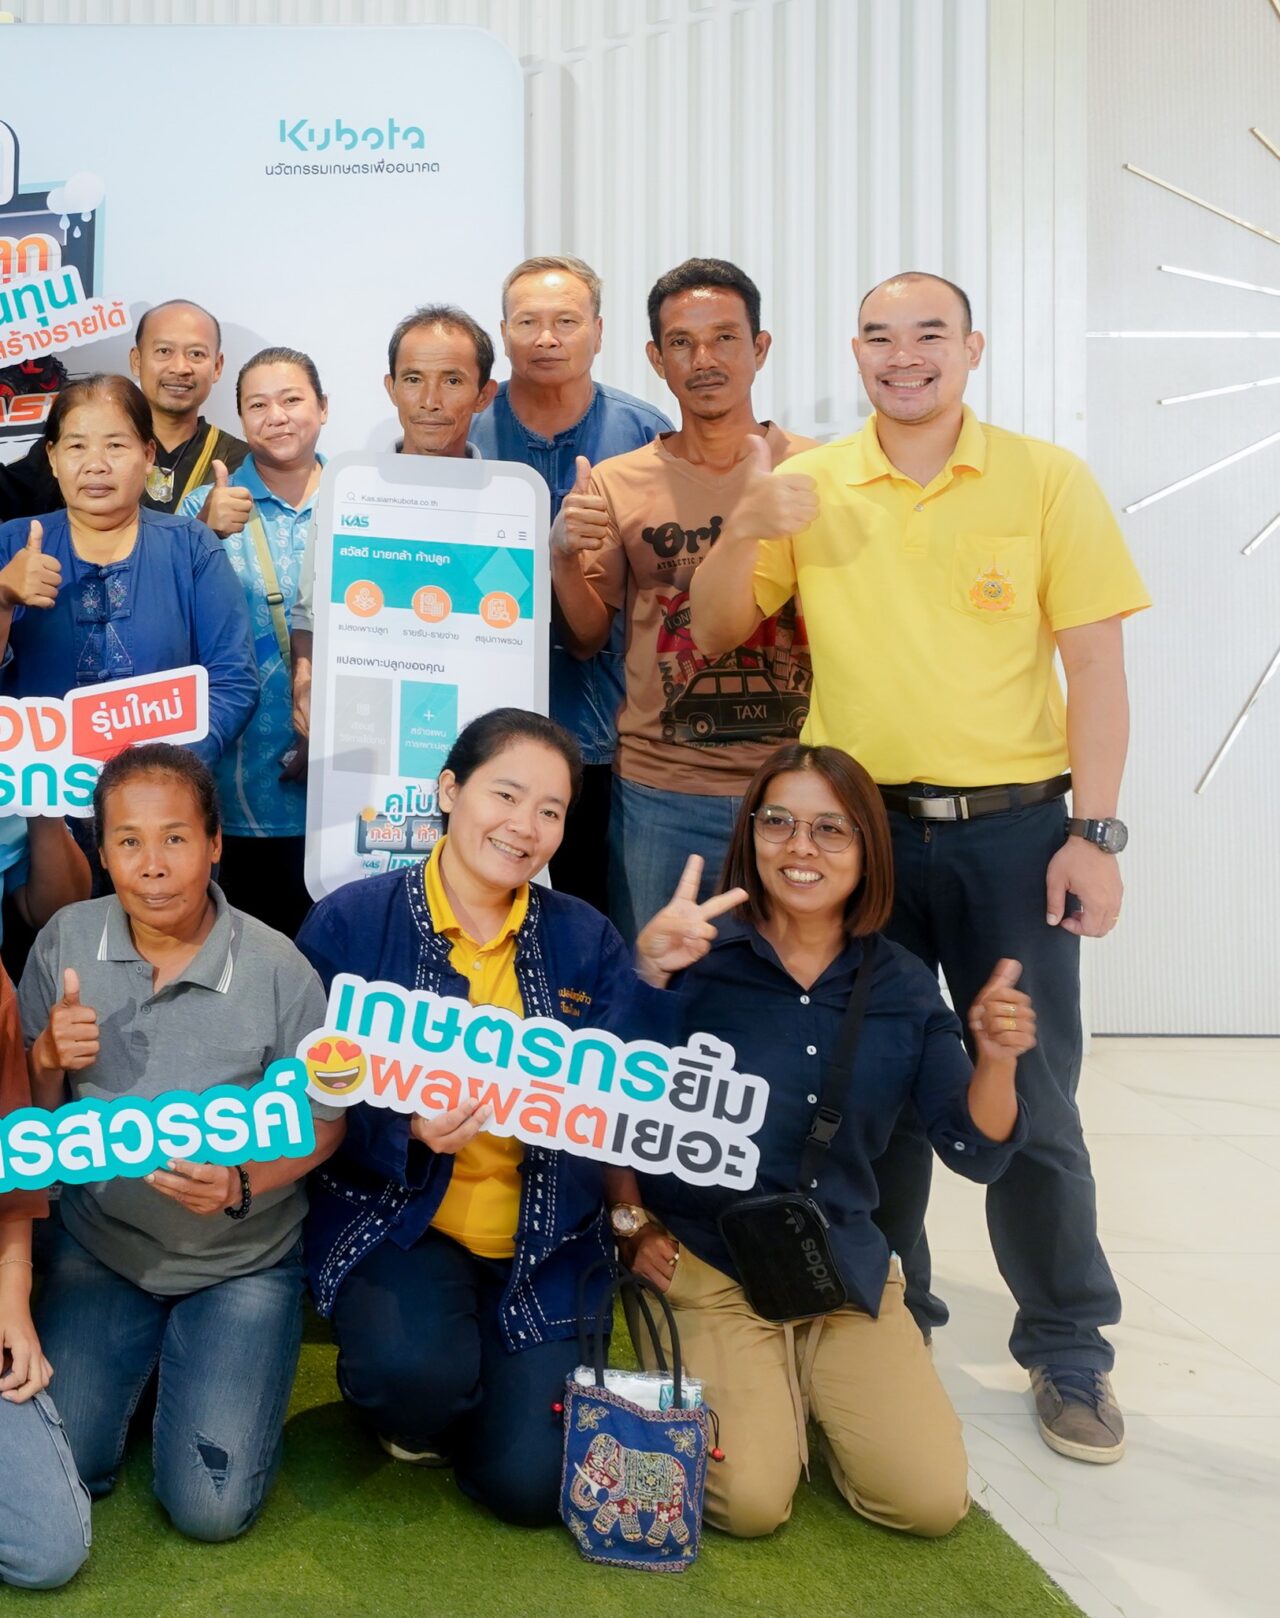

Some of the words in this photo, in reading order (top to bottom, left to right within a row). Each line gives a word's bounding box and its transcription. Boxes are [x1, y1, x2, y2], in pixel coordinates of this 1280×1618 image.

[279, 118, 425, 151] Kubota
[265, 158, 440, 176] นวัตกรรมเกษตรเพื่ออนาคต
[341, 514, 370, 528] KAS
[339, 545, 369, 558] สวัสดี
[372, 549, 412, 562] นายกล้า
[415, 551, 450, 566] ท้าปลูก
[402, 628, 460, 641] รายรับ-รายจ่าย
[475, 634, 523, 646] สรุปภาพรวม
[336, 655, 445, 674] แปลงเพาะปลูกของคุณ
[91, 688, 184, 740] รุ่นใหม่
[732, 704, 768, 720] TAXI
[370, 823, 401, 840] กล้า
[417, 823, 438, 840] ท้า
[335, 984, 756, 1125] เกษตรกรยิ้ม
[370, 1054, 748, 1178] ผลผลิตเยอะ
